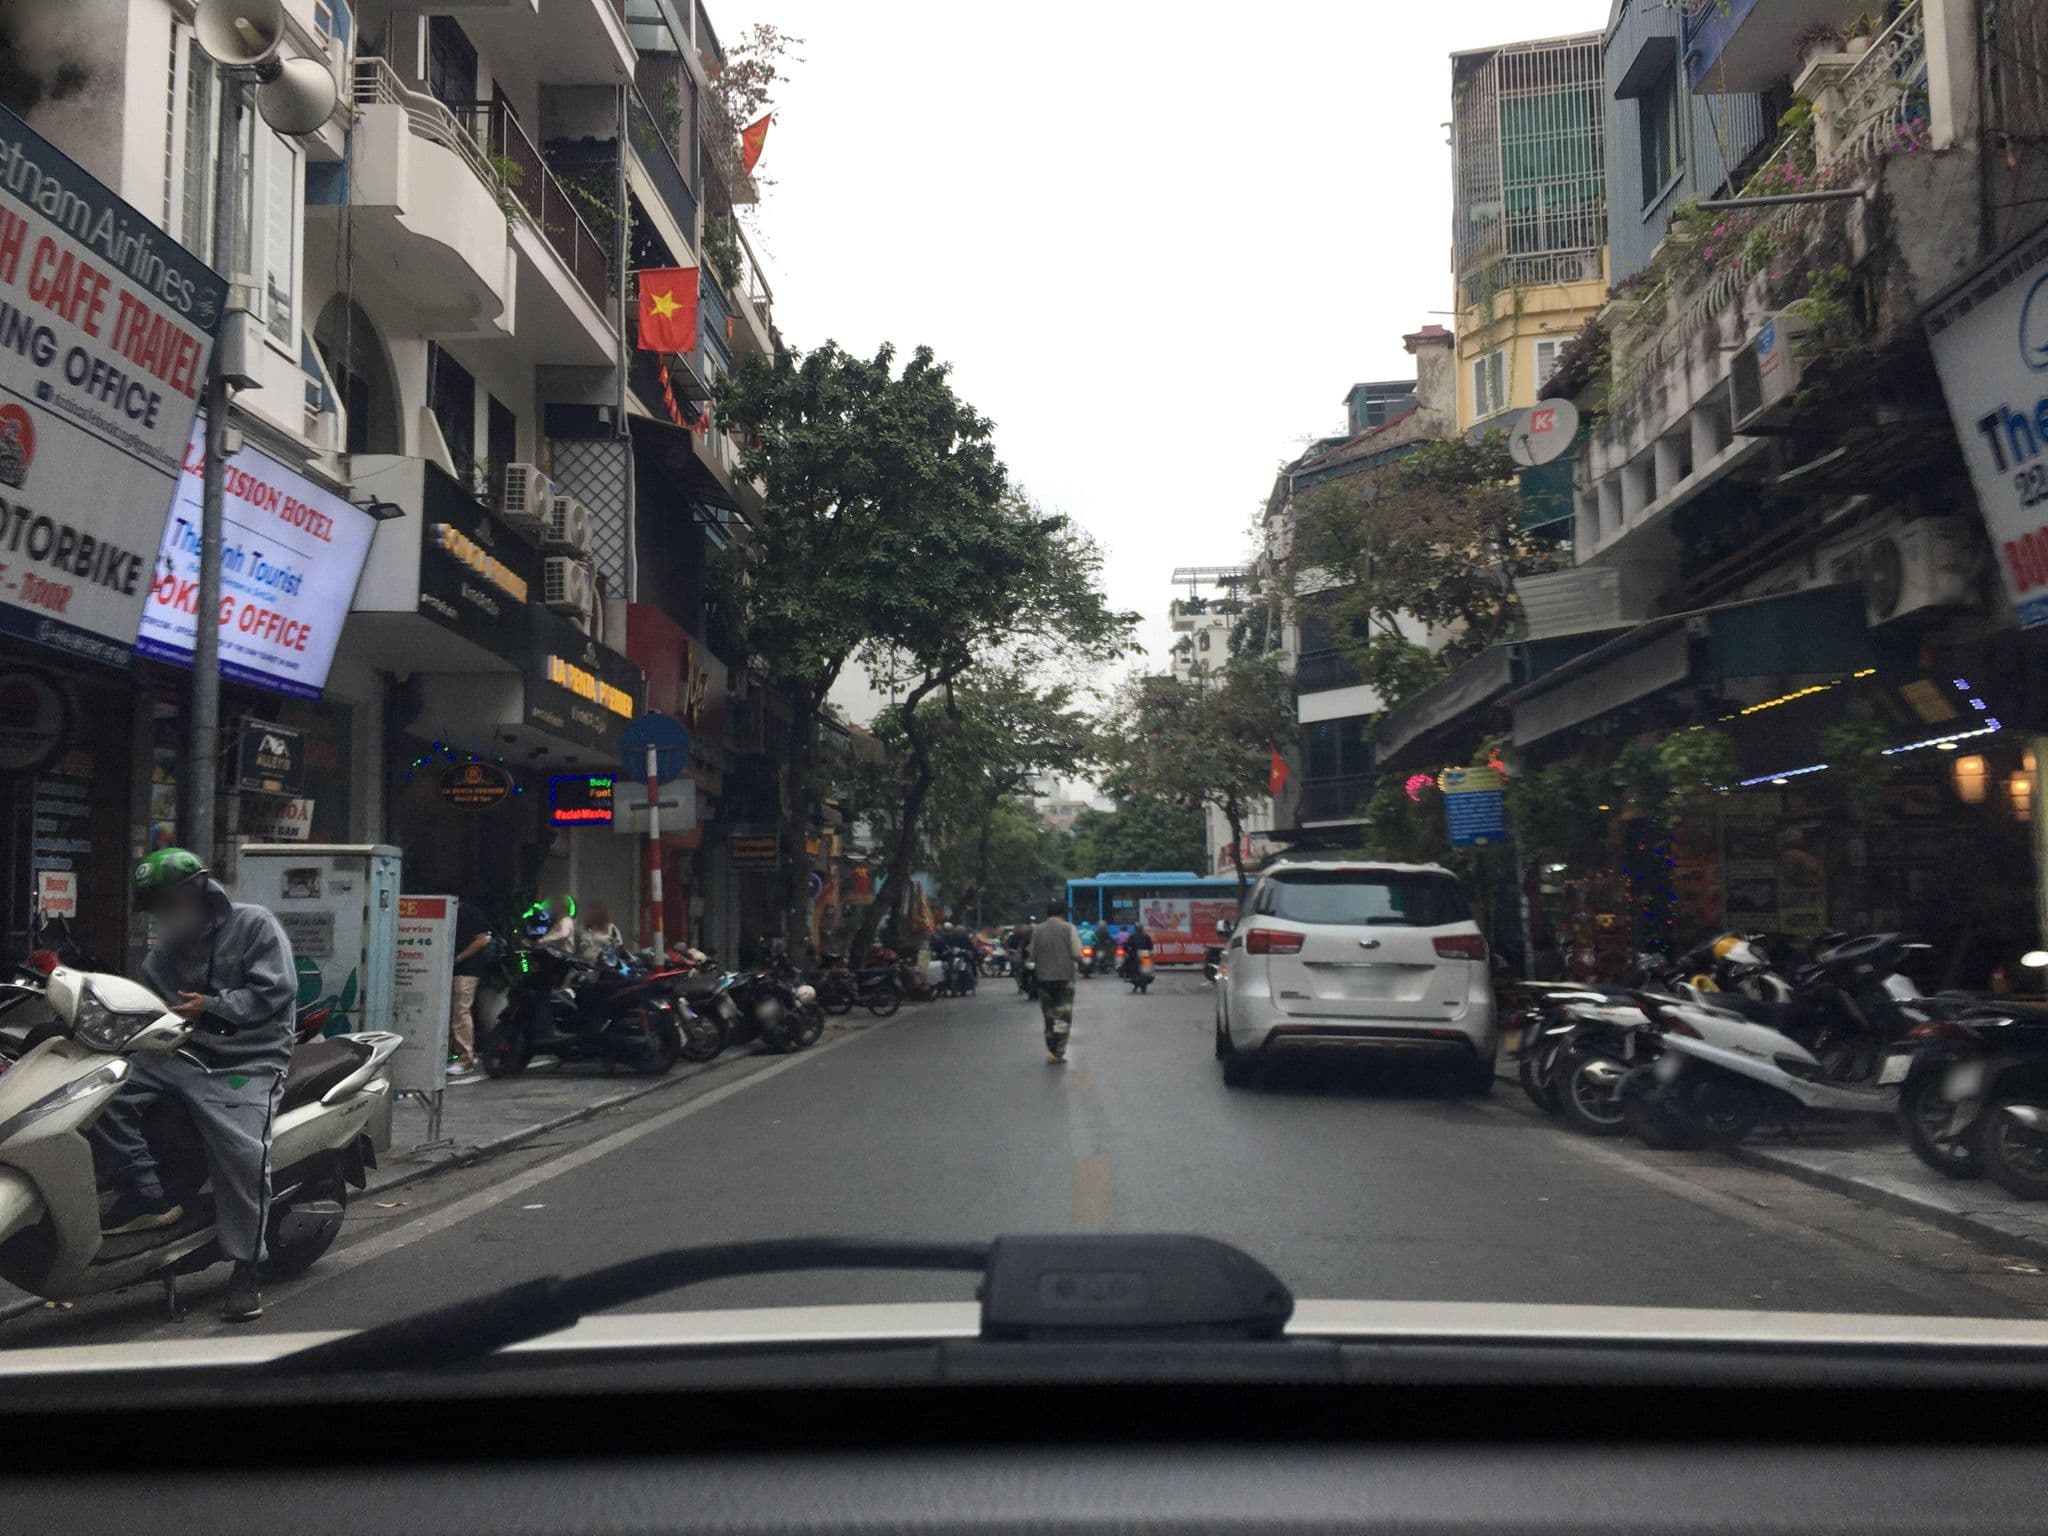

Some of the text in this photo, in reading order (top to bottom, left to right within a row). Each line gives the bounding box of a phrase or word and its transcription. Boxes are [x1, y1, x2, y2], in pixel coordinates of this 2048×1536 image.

[88, 207, 196, 313] Airlines
[28, 235, 112, 339] CAFE
[110, 288, 204, 401] TRAVEL
[65, 346, 162, 430] OFFICE
[223, 464, 283, 514] ISION
[279, 495, 335, 543] HOTEL
[247, 551, 304, 597] Tourist
[238, 603, 312, 652] OFFICE
[589, 788, 612, 798] Foot
